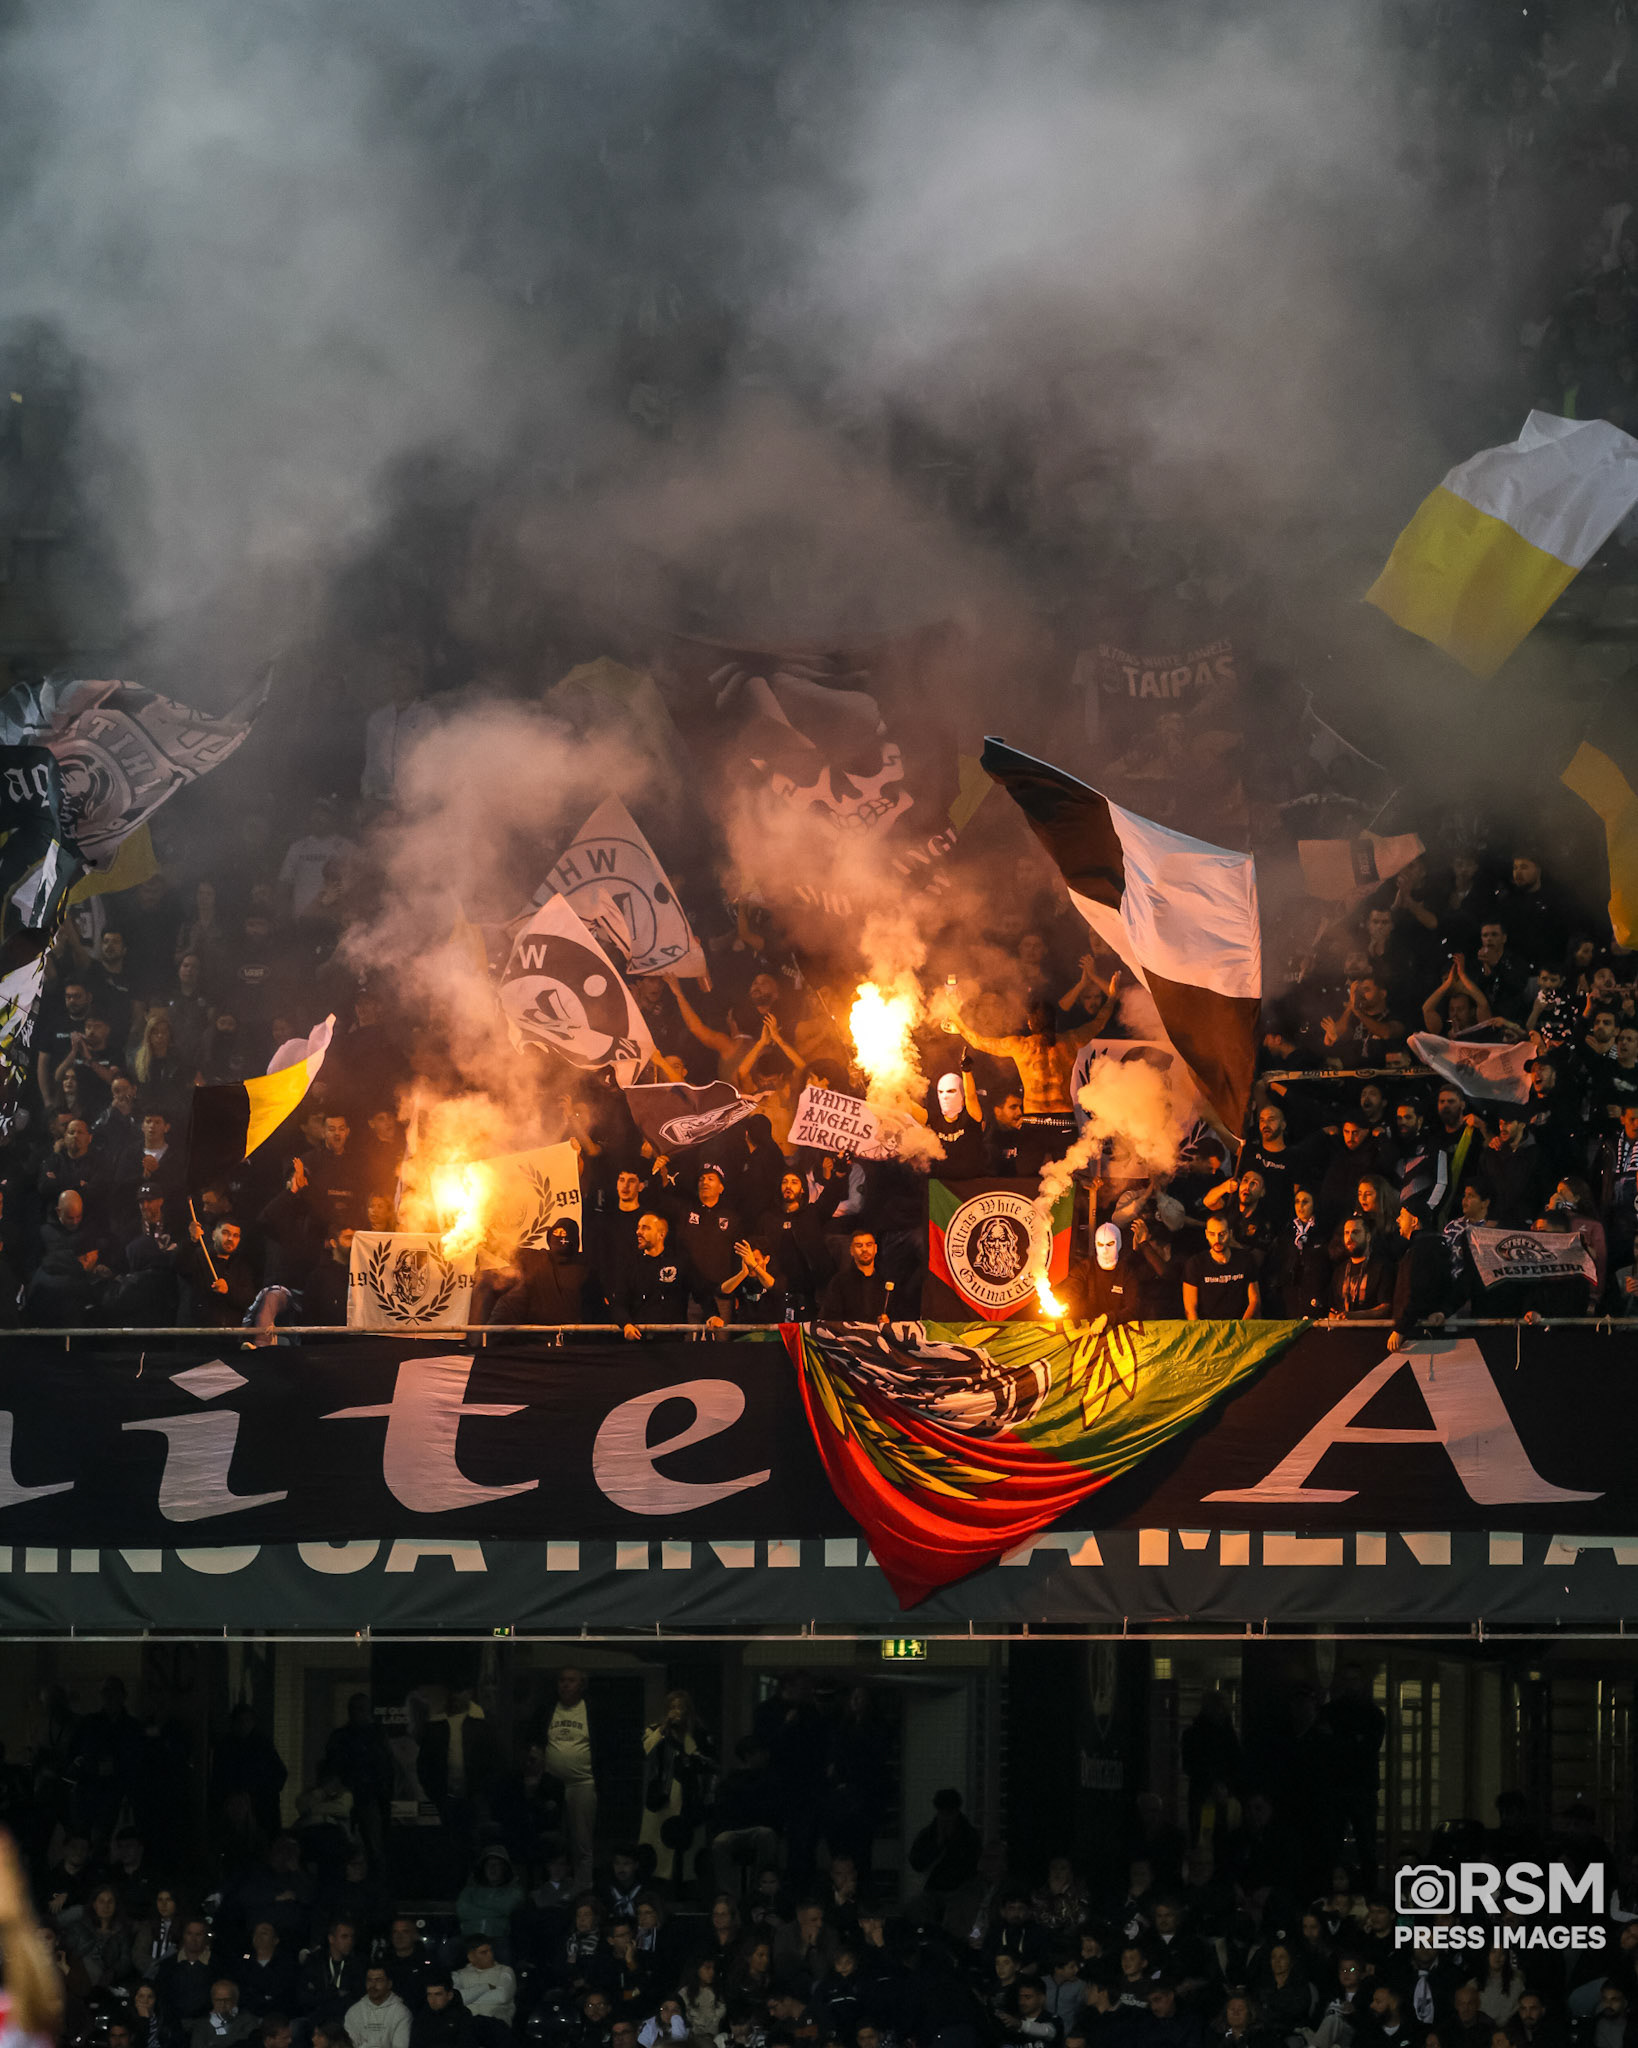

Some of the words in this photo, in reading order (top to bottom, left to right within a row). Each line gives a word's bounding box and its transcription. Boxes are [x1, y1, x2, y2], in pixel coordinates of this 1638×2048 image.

[1122, 655, 1236, 697] TAIPAS
[808, 1087, 862, 1118] WHITE
[797, 1123, 861, 1153] ZÜRICH
[802, 1107, 873, 1140] ANGELS
[979, 1199, 1021, 1215] White
[1492, 1263, 1586, 1278] NESPEREIRA
[1200, 1338, 1606, 1505] A
